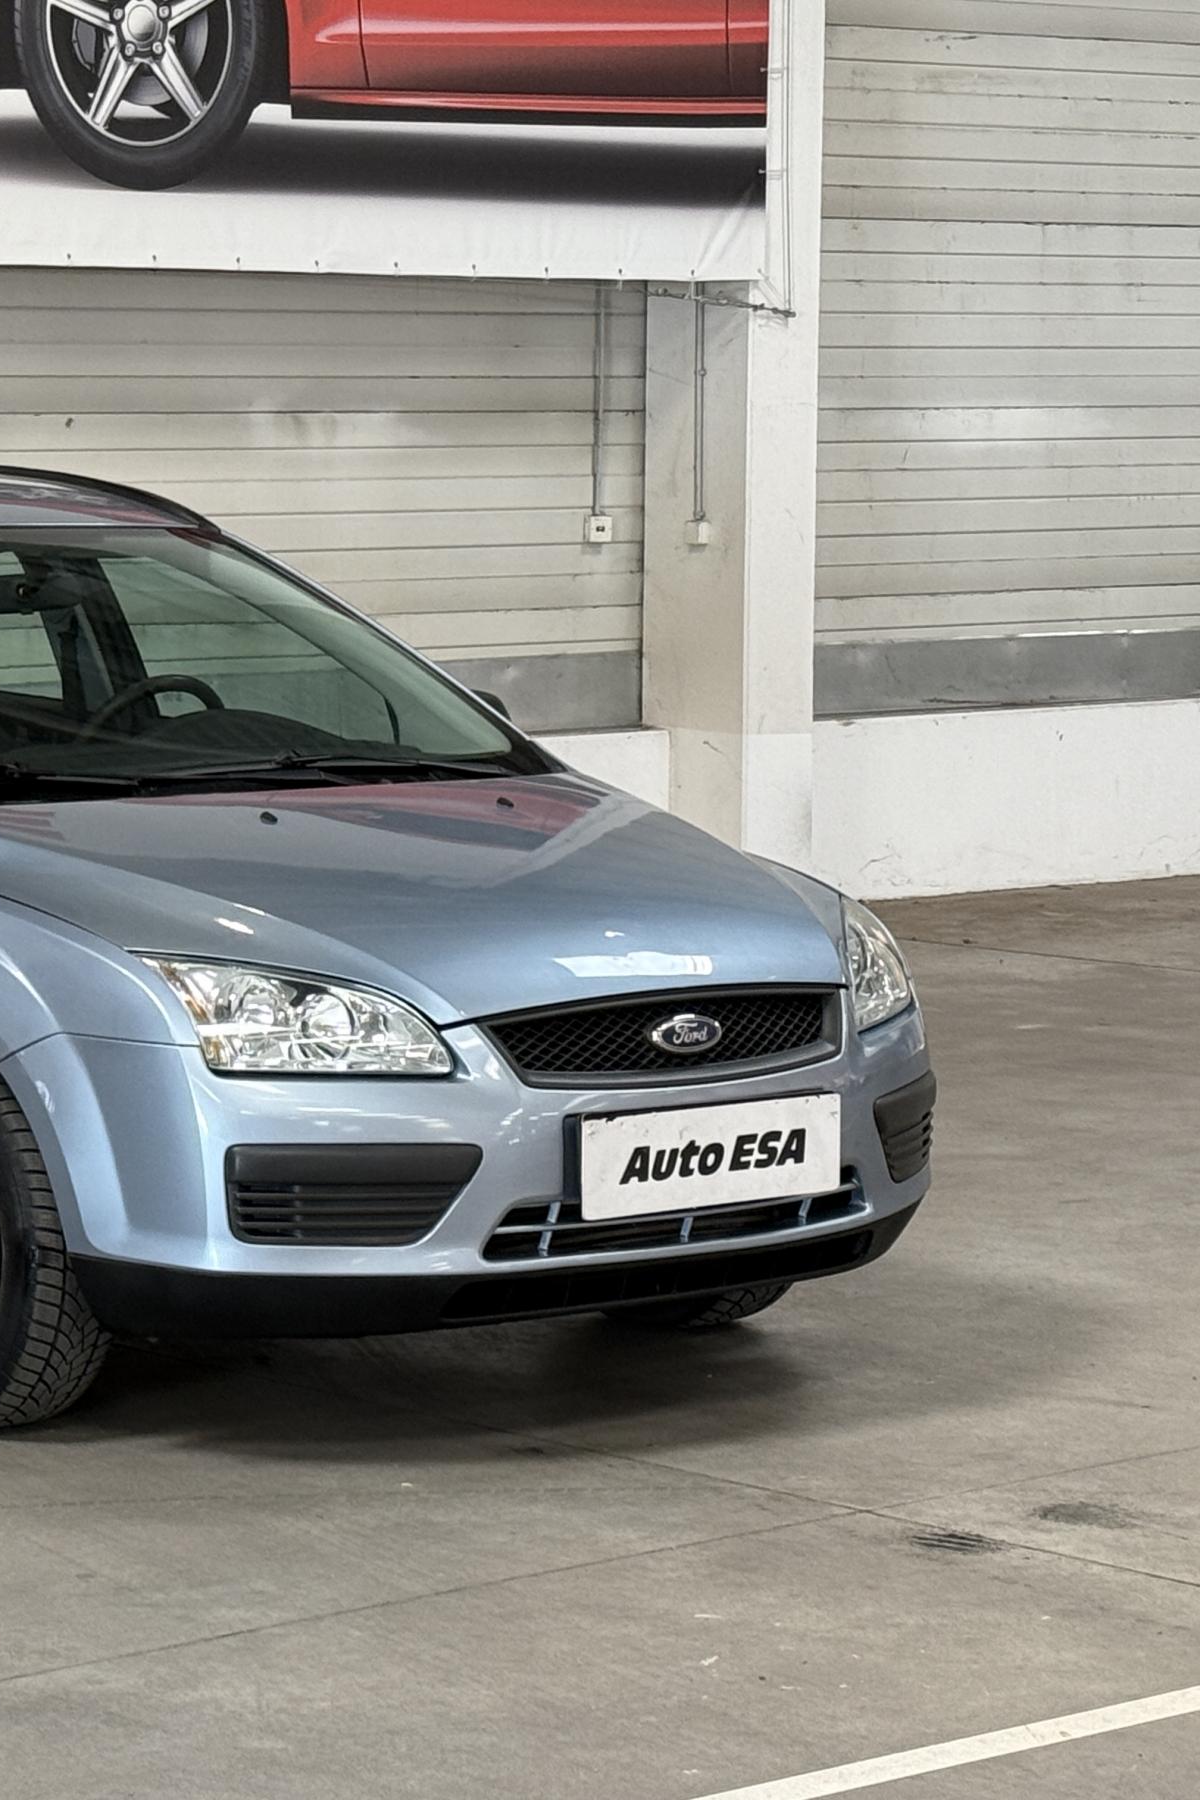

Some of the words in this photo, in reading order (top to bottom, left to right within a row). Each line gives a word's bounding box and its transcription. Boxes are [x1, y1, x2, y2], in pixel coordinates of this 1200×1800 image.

[673, 1021, 708, 1044] Ford
[619, 1140, 724, 1185] Auto
[729, 1128, 806, 1171] ESA
